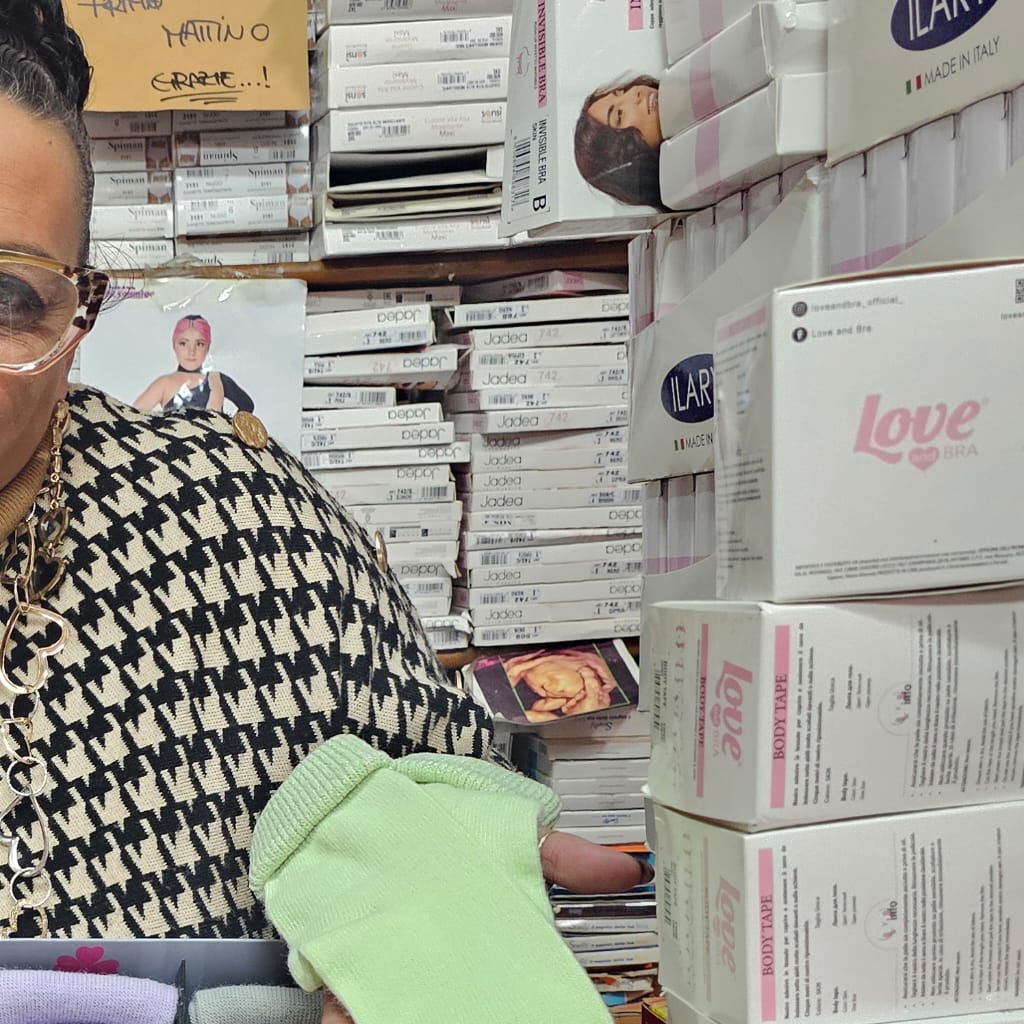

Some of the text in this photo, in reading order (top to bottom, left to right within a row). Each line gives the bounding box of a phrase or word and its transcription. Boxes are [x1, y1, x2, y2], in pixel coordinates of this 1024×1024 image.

[925, 36, 1000, 85] MADE IN ITALY
[537, 76, 547, 105] BRA
[537, 119, 546, 186] INVISIBLE BRA
[532, 194, 547, 213] B
[484, 330, 528, 345] Jadea
[483, 373, 527, 385] Jadea
[497, 415, 539, 428] Jadea
[853, 394, 982, 466] Love
[483, 435, 521, 448] Jadea
[686, 434, 704, 449] MADE
[484, 453, 522, 466] Jadea
[943, 444, 979, 460] BRA
[484, 475, 522, 487] Jadea
[480, 496, 523, 508] Jadea
[483, 570, 521, 581] Jadea
[485, 608, 523, 621] Jadea
[716, 660, 753, 764] Love
[773, 674, 788, 760] BODY TAPE
[761, 894, 774, 976] BODY TAPE
